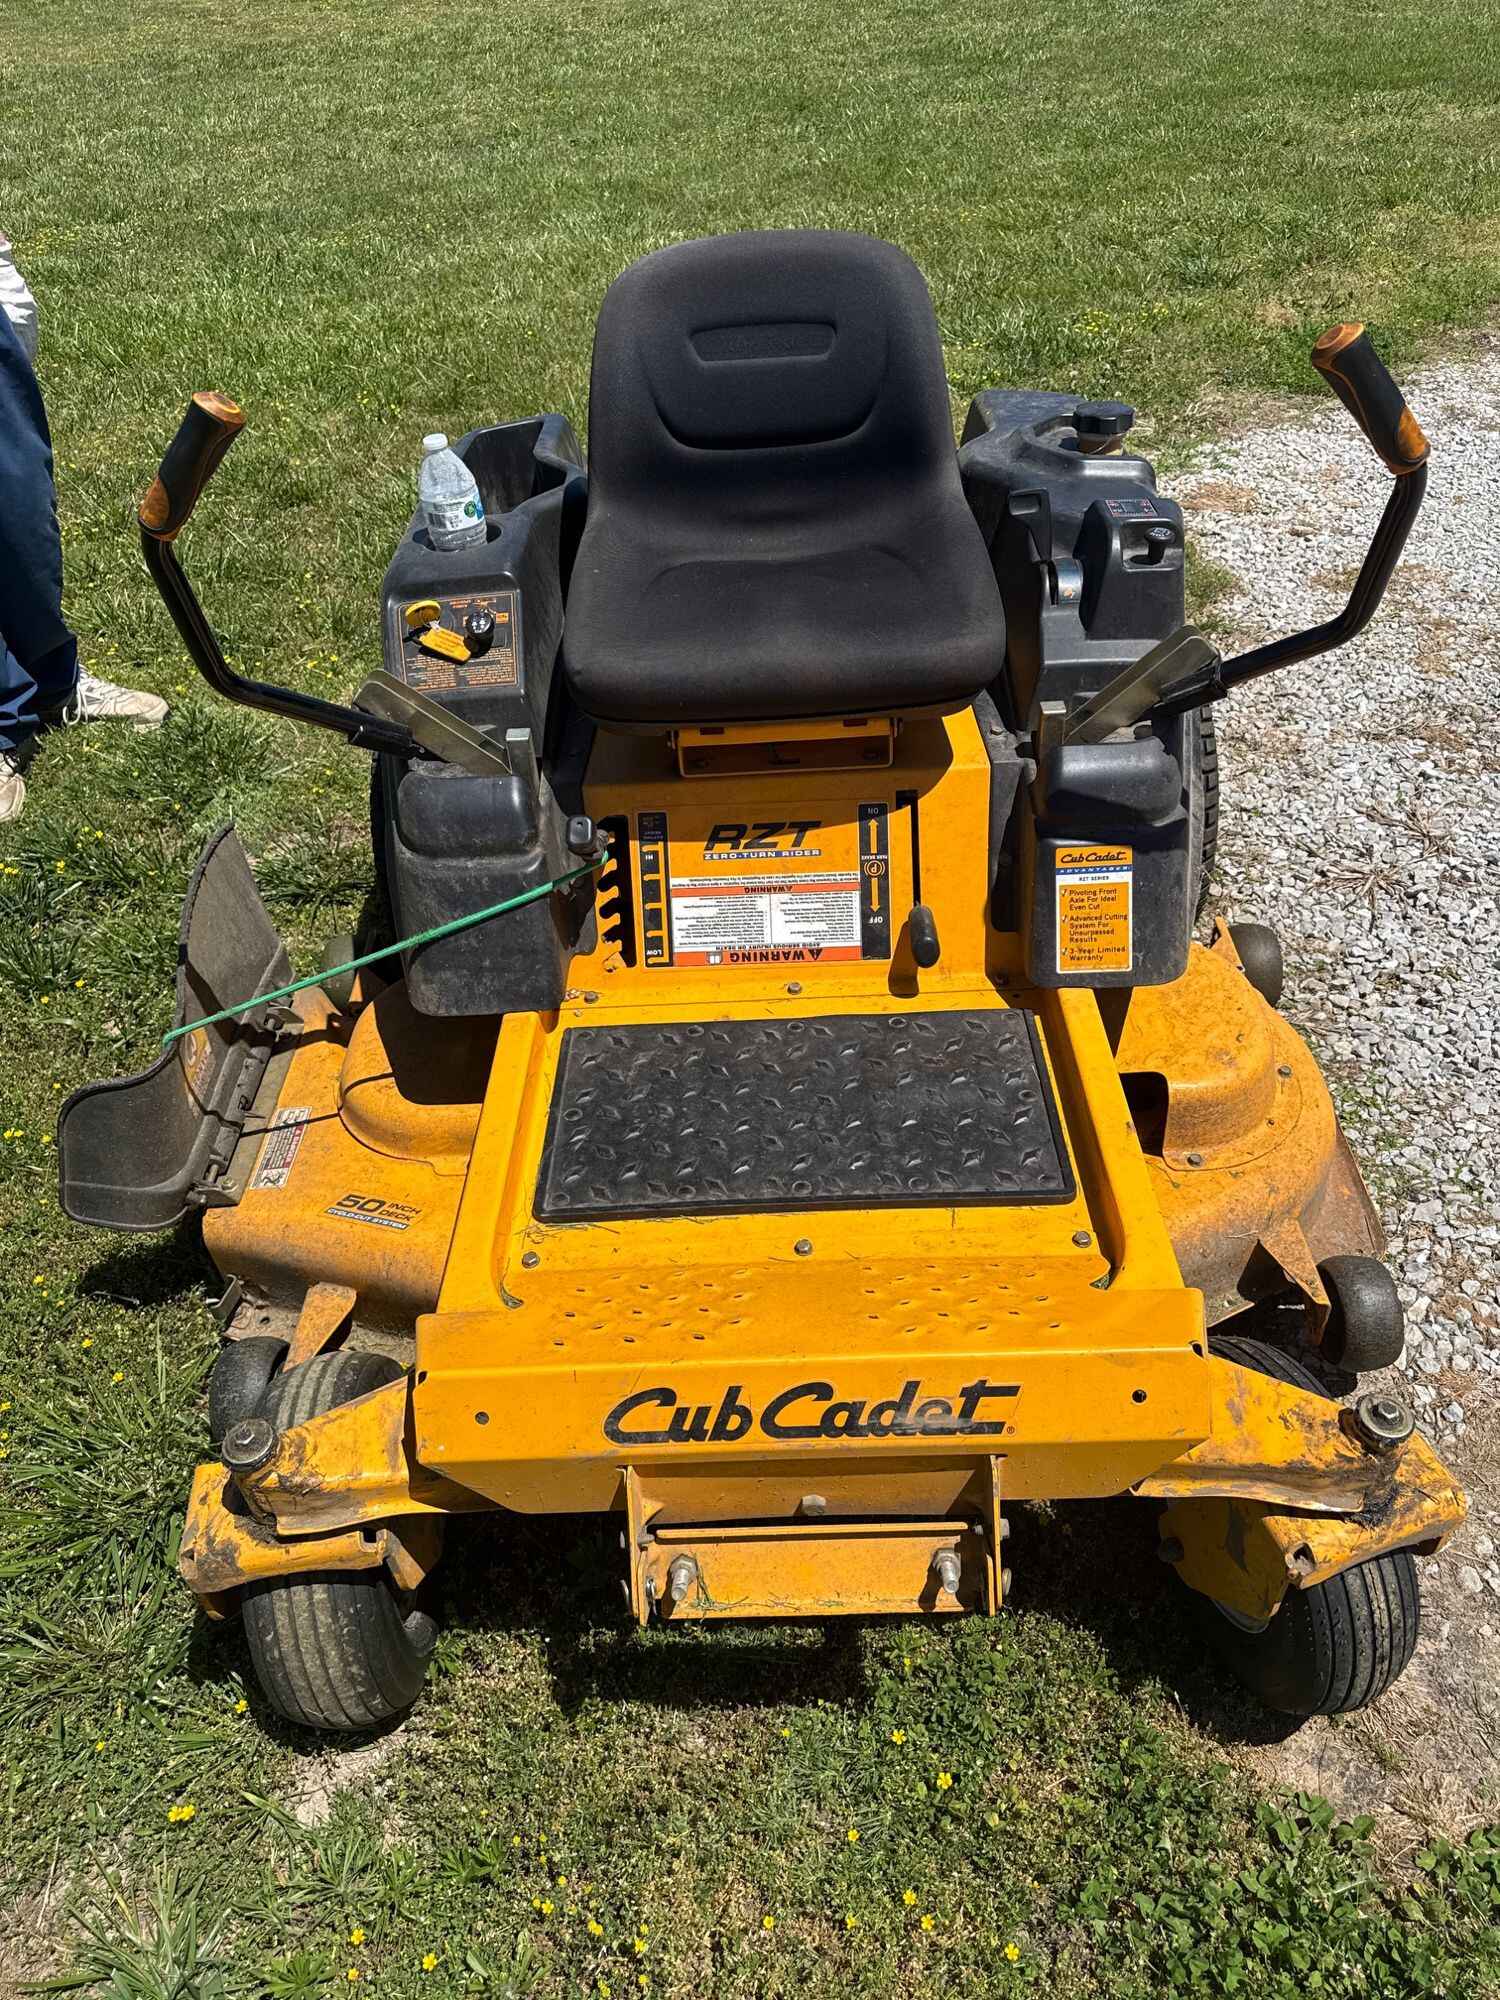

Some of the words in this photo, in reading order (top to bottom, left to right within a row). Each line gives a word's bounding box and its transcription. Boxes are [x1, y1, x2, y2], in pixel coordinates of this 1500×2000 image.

[704, 820, 822, 851] RZT
[704, 851, 776, 860] ZERO-TURN
[782, 849, 820, 857] RIDER
[1061, 853, 1084, 863] Cub
[1085, 851, 1127, 862] Cadet
[744, 885, 786, 894] WARNING
[729, 949, 805, 962] WARNING
[336, 1193, 387, 1213] 50
[388, 1202, 422, 1214] INCH
[378, 1209, 416, 1221] DECK
[603, 1386, 754, 1444] Cub
[759, 1379, 1021, 1439] Cadet
